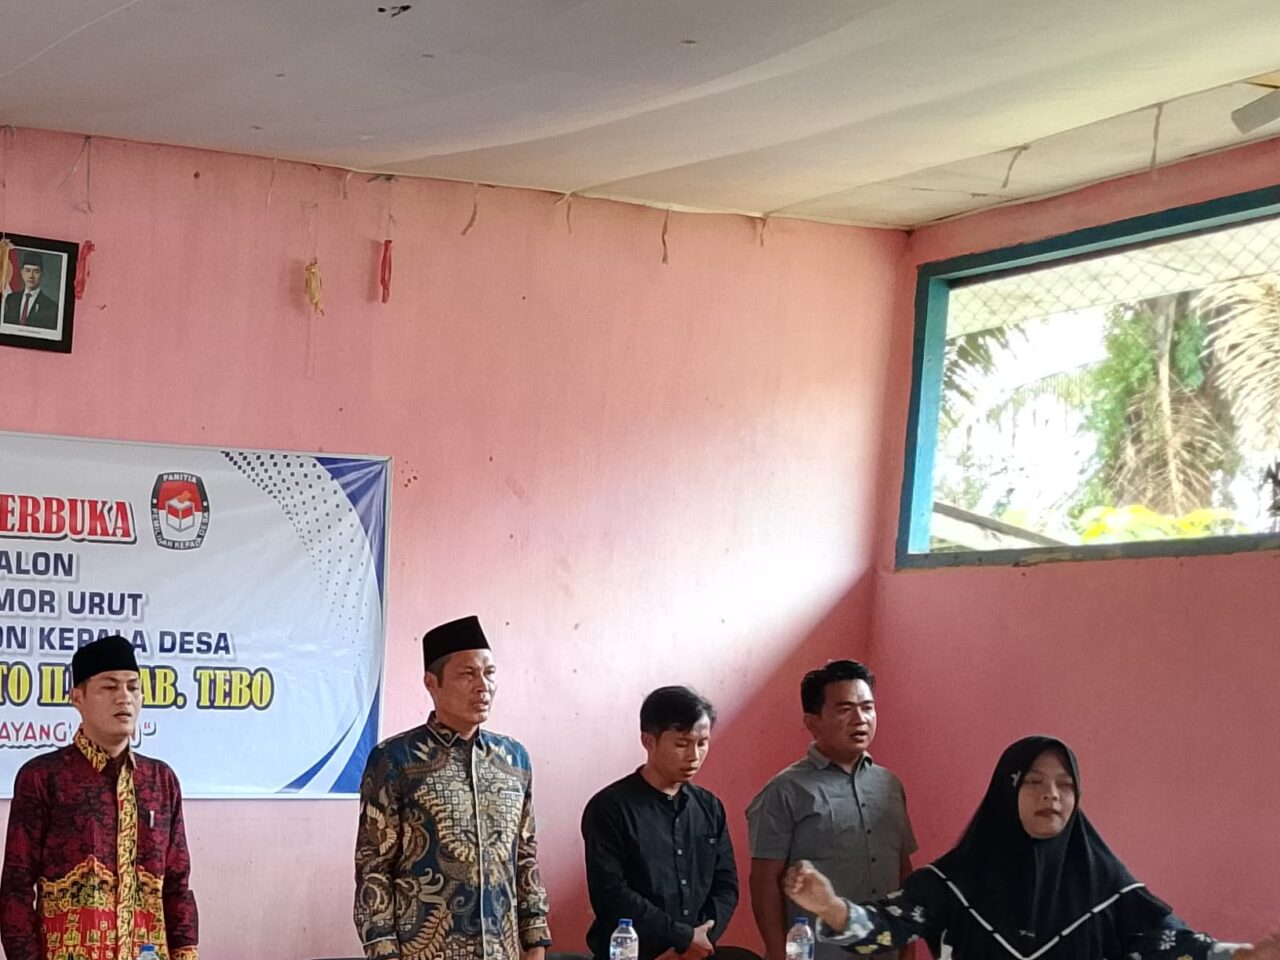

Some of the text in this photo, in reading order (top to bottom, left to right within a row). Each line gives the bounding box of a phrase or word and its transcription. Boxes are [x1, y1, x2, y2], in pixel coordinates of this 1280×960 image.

[163, 473, 197, 484] PANITIA
[67, 590, 143, 616] URUT
[39, 626, 147, 653] KEPA
[158, 631, 231, 655] DESA
[37, 662, 72, 707] IL
[138, 665, 186, 709] AB.
[194, 666, 274, 711] TEBO
